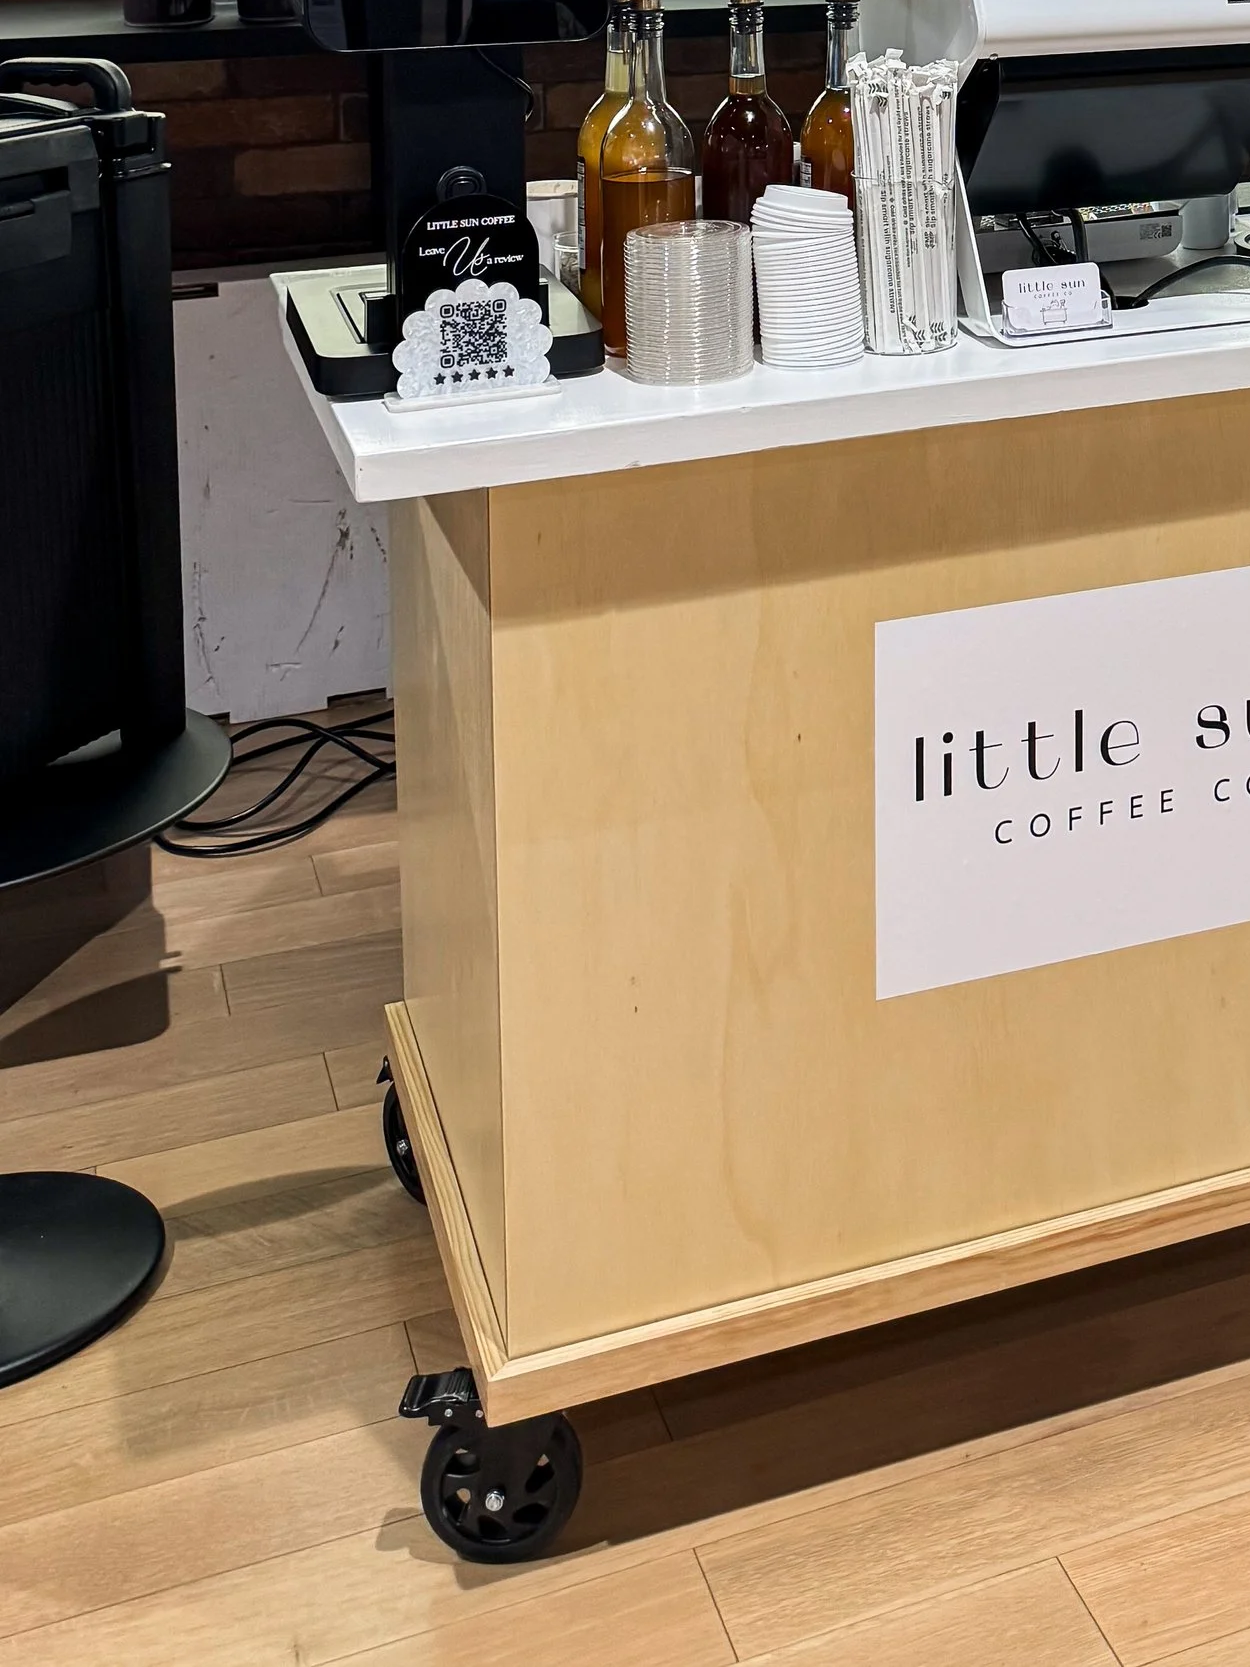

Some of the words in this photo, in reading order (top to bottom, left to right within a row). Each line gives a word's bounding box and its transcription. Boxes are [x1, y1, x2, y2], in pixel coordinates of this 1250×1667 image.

[904, 138, 913, 180] sugarcane
[926, 132, 934, 173] sugarcane
[426, 220, 459, 230] LITTLE
[460, 218, 480, 228] SUN
[480, 215, 516, 226] COFFEE
[418, 246, 446, 256] Leave
[442, 236, 490, 276] Us
[494, 254, 524, 264] review
[1019, 281, 1054, 293] little
[1061, 280, 1085, 289] sun
[915, 708, 1141, 802] little
[994, 788, 1176, 845] COFFEE
